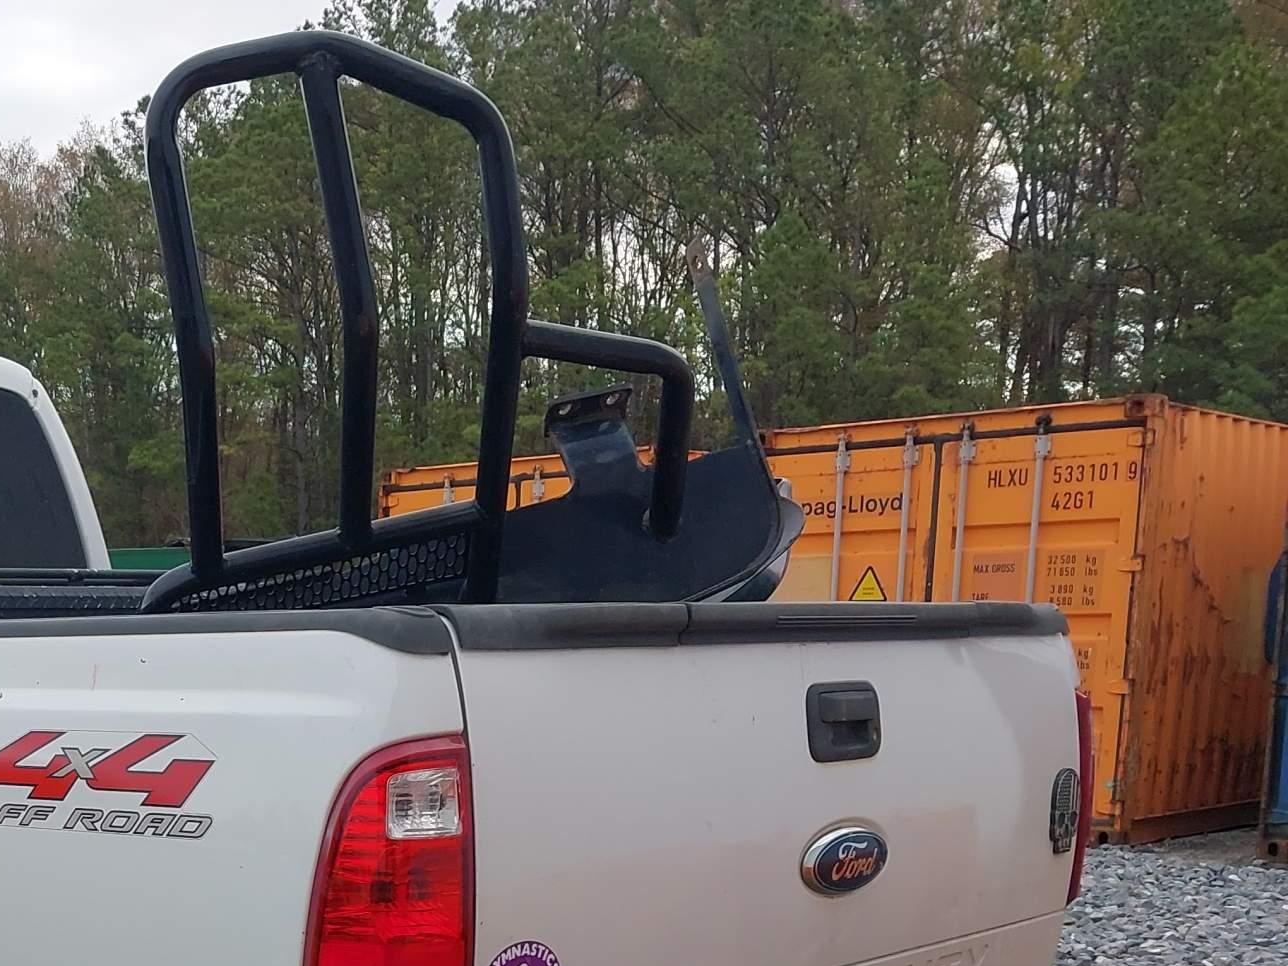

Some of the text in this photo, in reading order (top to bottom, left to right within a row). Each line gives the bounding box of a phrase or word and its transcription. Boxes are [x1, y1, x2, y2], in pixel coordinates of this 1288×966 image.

[987, 468, 1029, 488] HLXU
[1053, 462, 1120, 484] 533101
[1051, 490, 1095, 511] 42G1
[973, 564, 990, 574] MAX
[1085, 554, 1097, 567] kg
[63, 808, 215, 839] ROAD
[832, 841, 878, 881] Ford
